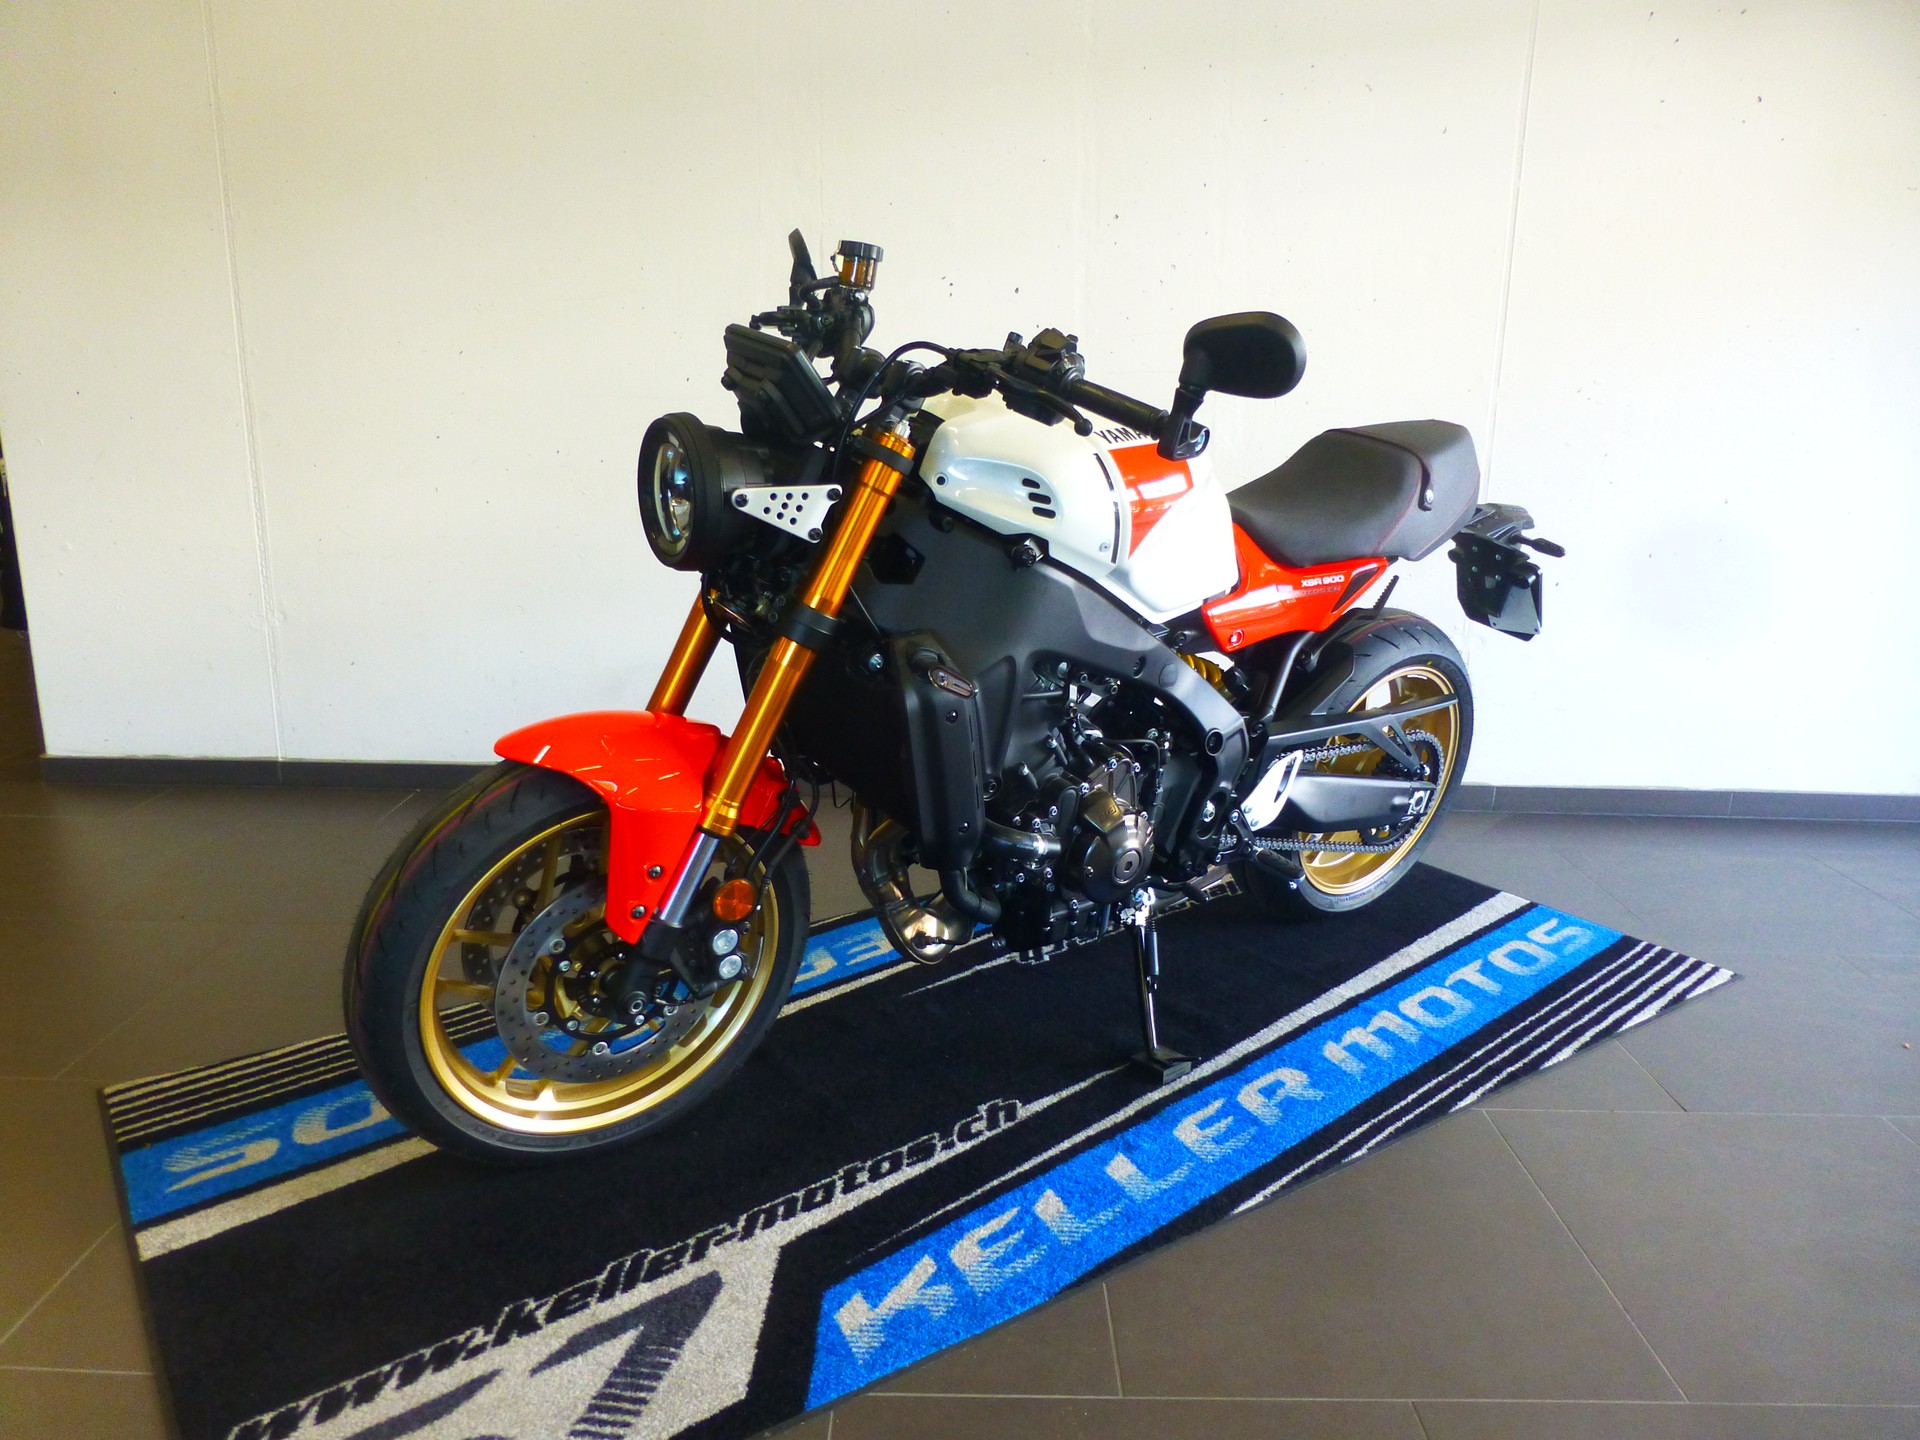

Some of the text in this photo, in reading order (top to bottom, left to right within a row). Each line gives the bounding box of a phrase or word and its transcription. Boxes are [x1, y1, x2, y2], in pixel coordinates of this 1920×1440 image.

[1093, 426, 1149, 444] YAMA
[1301, 574, 1345, 588] XSR 900
[834, 917, 1597, 1364] KELLER MOTOS
